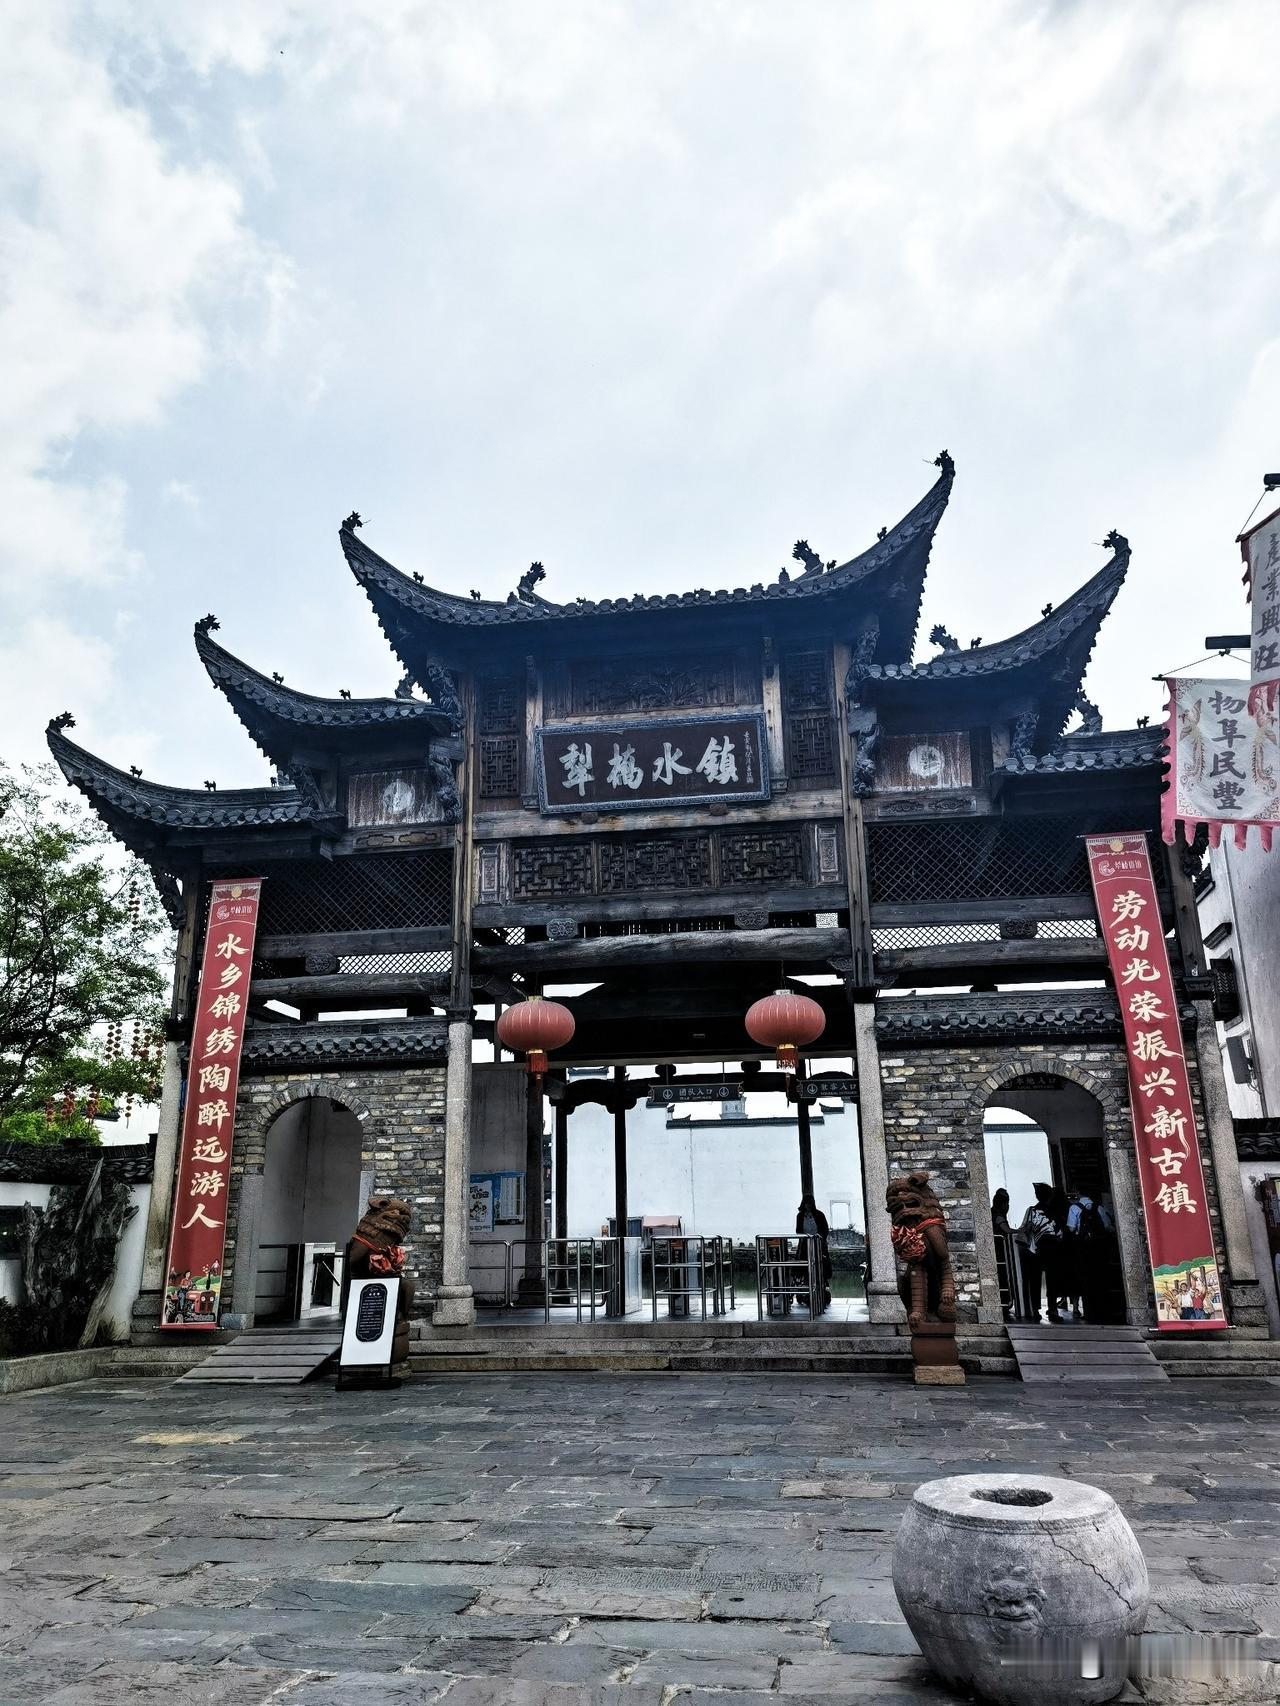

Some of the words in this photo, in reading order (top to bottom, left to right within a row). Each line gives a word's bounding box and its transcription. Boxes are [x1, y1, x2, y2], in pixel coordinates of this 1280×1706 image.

[181, 933, 250, 1229] 水乡锦绣陶醉远游人
[1109, 890, 1198, 1214] 劳动光荣振兴新古镇
